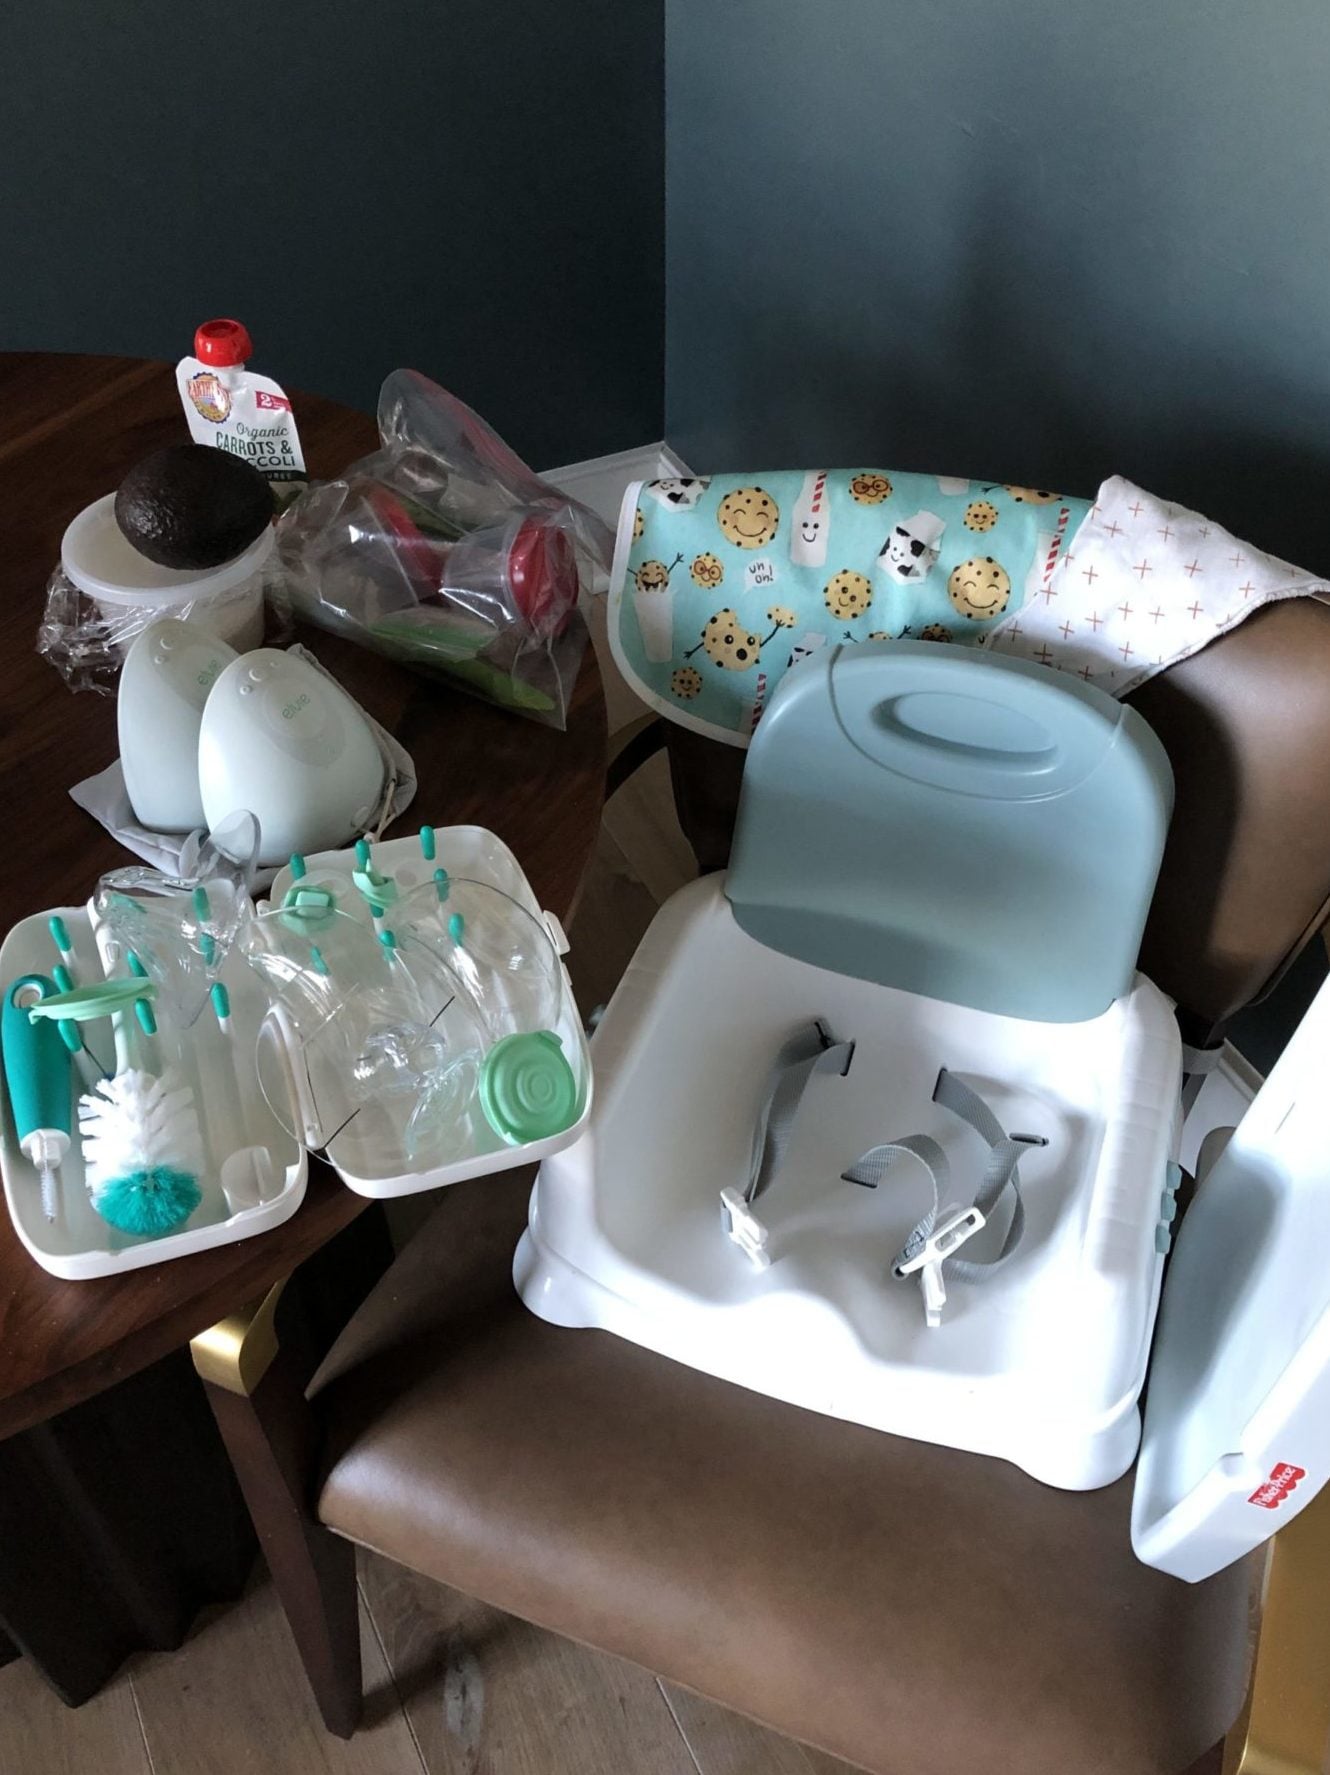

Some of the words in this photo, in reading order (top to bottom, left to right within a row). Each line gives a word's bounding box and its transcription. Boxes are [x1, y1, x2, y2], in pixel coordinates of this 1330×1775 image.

[260, 393, 273, 408] 2
[236, 422, 289, 441] Organic
[216, 431, 276, 456] CARROTS
[280, 440, 293, 455] &
[246, 456, 296, 467] CCOLI
[281, 694, 311, 720] elvie
